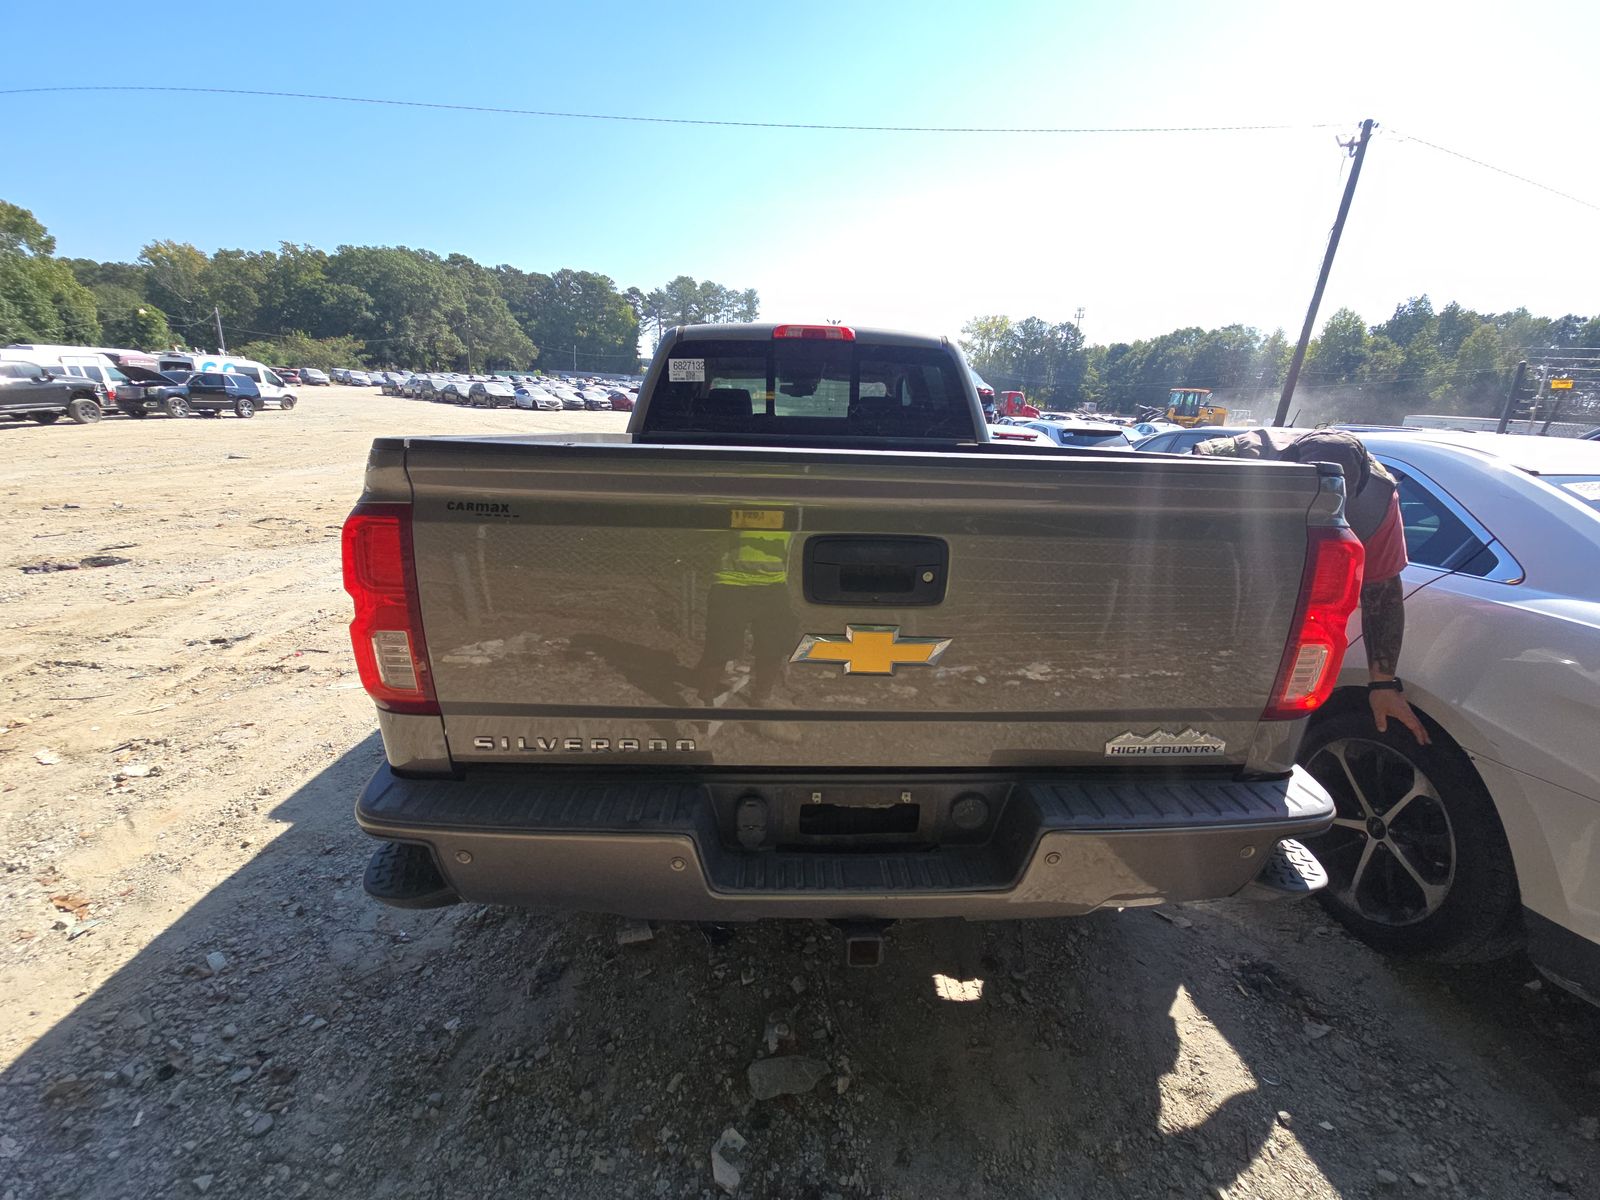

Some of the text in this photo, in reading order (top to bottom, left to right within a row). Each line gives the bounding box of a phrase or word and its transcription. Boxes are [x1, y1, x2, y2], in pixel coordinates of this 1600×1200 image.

[673, 360, 705, 370] 6827132
[473, 736, 696, 752] SILVERADO
[1111, 745, 1221, 754] HIGH COUNTRY
